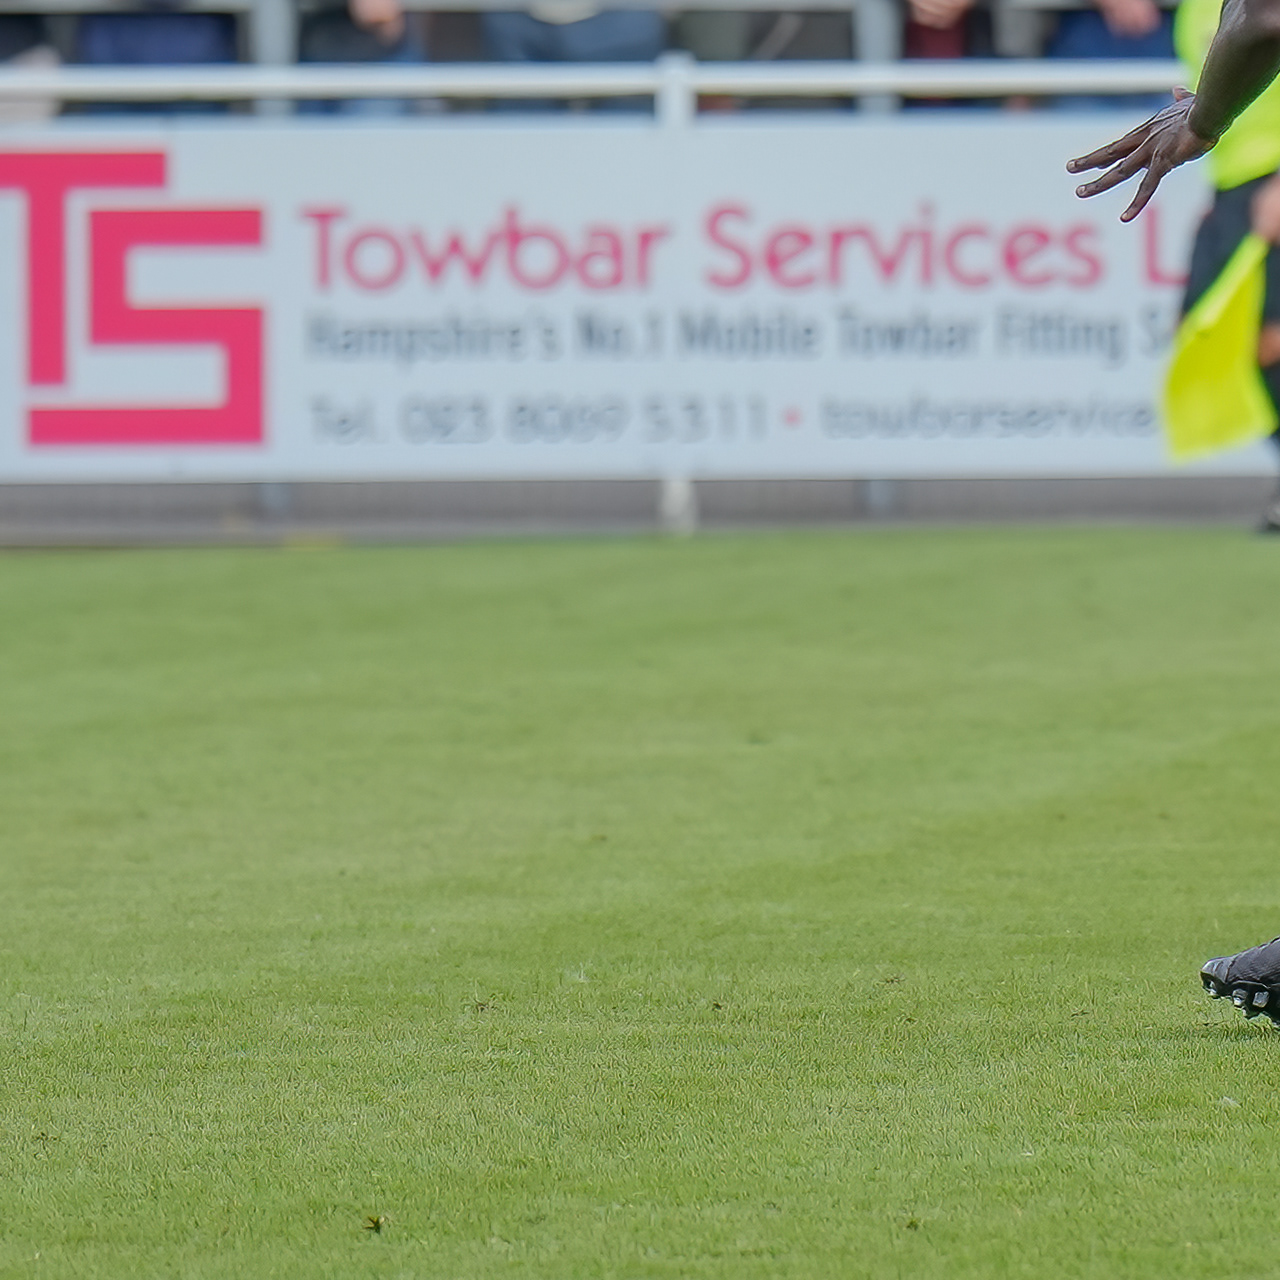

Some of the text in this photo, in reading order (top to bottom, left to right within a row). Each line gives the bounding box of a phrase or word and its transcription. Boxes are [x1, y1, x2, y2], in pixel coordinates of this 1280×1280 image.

[302, 204, 668, 292] Towbar
[705, 200, 1106, 292] Services
[0, 148, 265, 445] TS
[675, 307, 822, 362] Mobile
[836, 307, 980, 361] Towbar
[994, 304, 1126, 367] Fitting
[818, 391, 1160, 439] towbarservice
